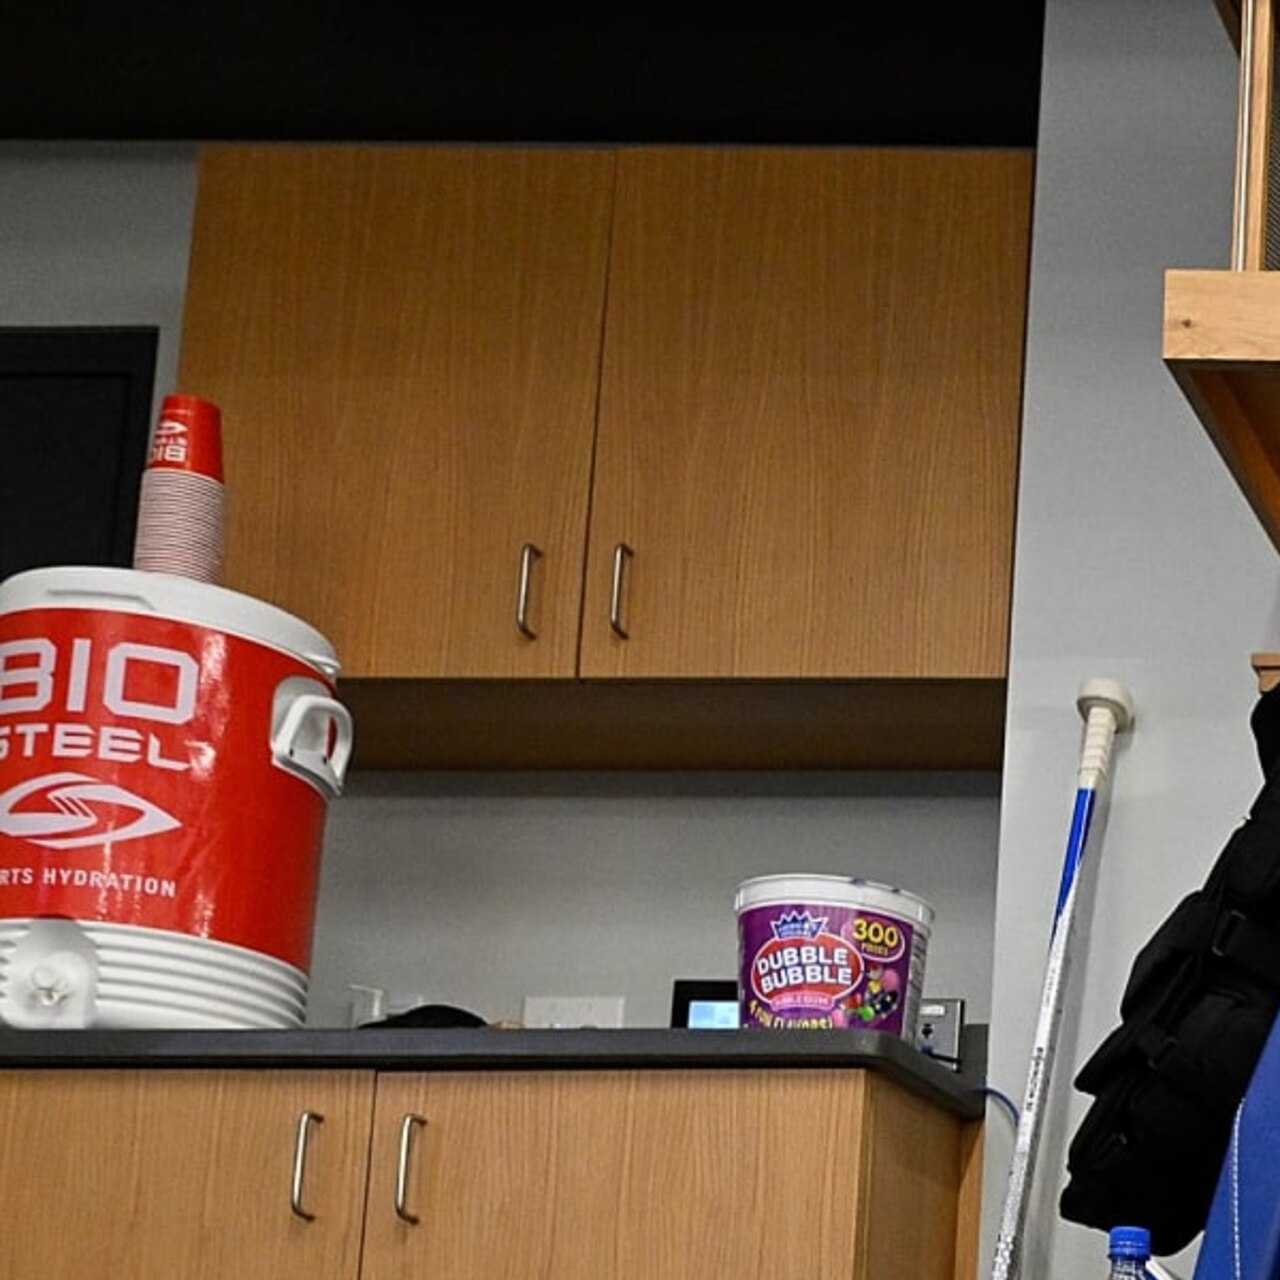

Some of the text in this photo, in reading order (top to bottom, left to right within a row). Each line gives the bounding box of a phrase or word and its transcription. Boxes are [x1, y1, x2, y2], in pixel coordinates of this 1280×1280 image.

[0, 637, 200, 725] BIO
[43, 867, 176, 898] HYDRATION
[853, 917, 899, 948] 300
[757, 945, 849, 977] DUBBLE
[760, 965, 853, 995] BUBBLE
